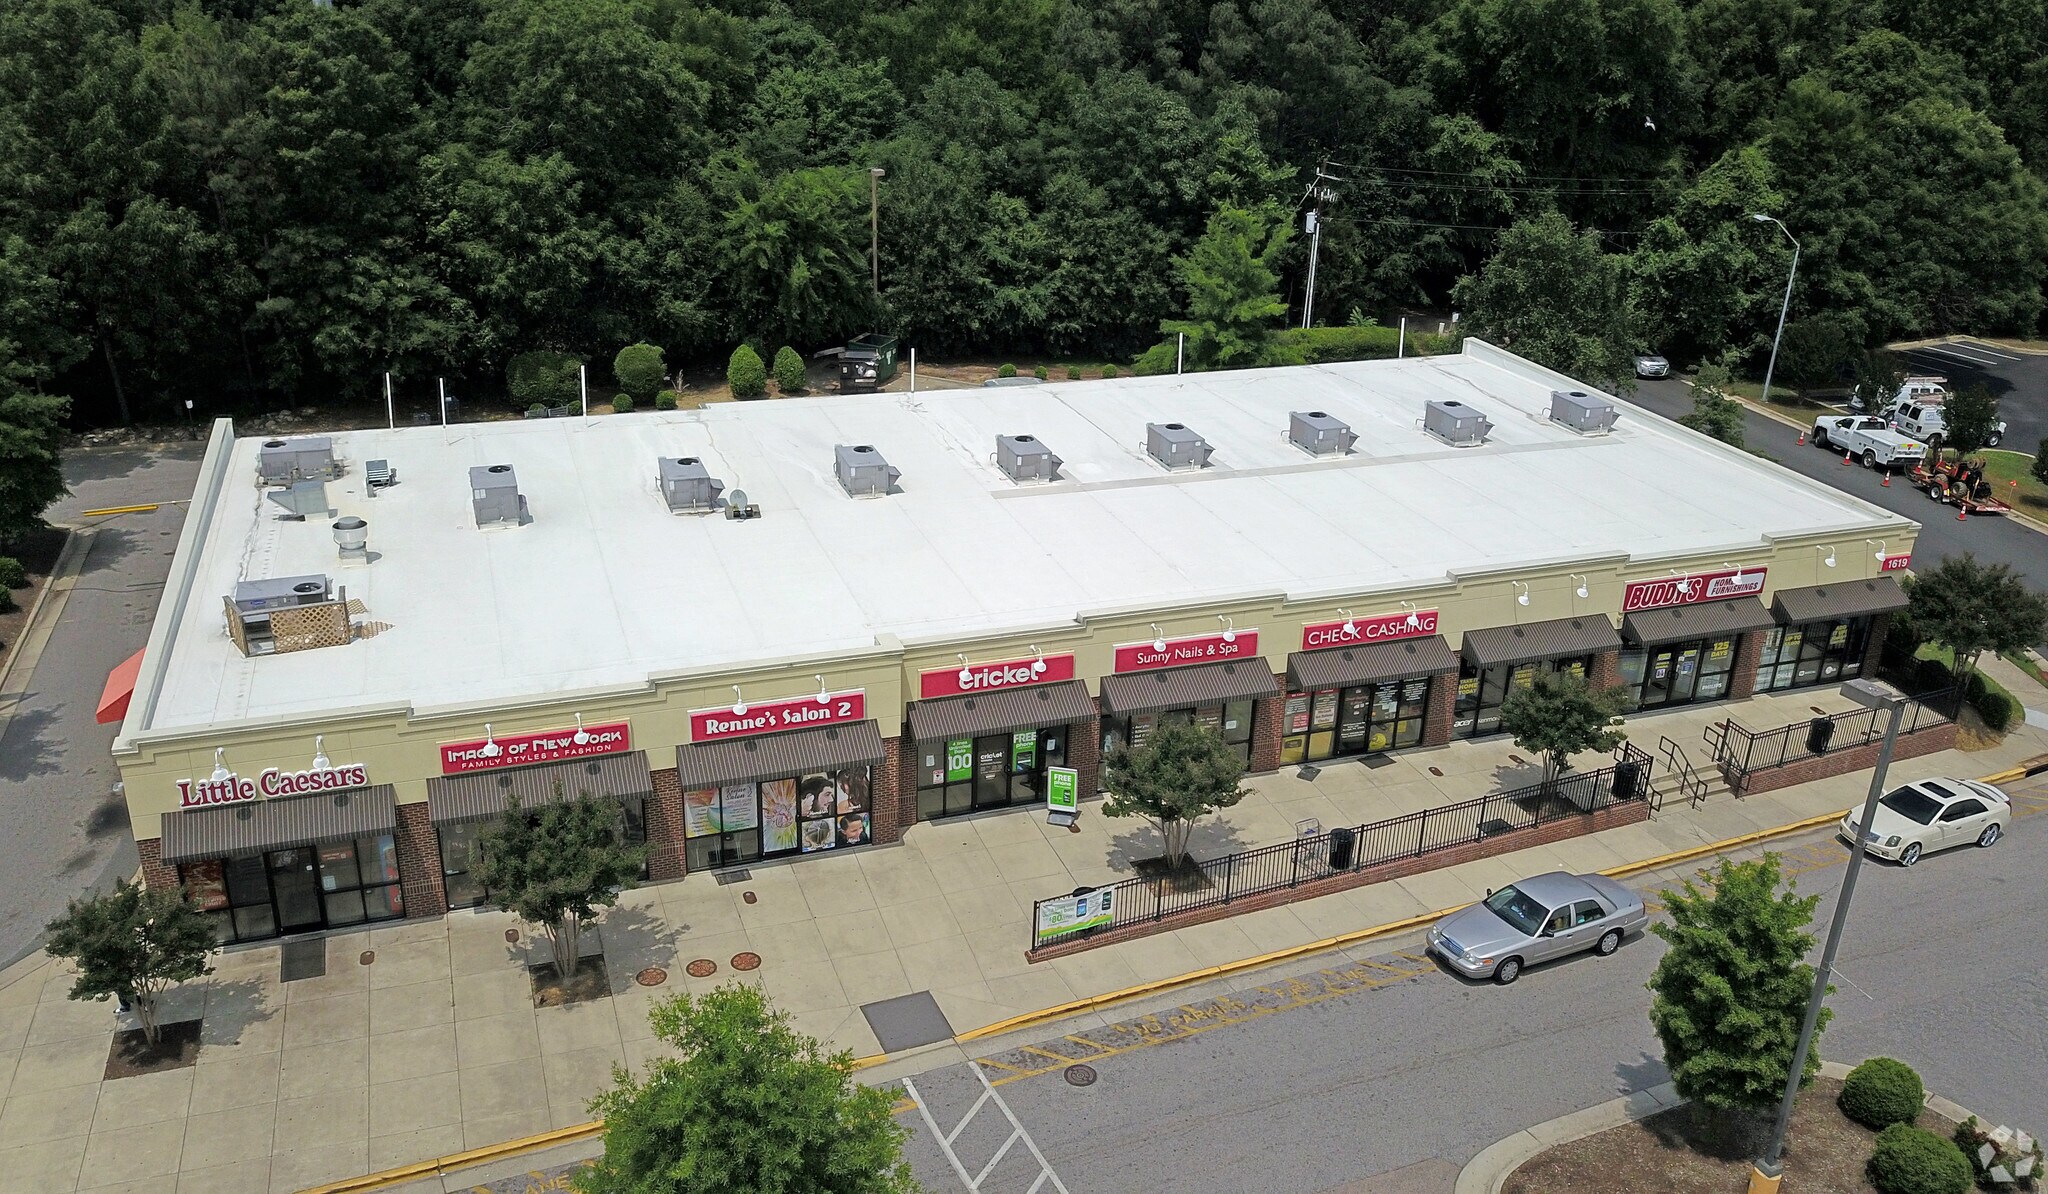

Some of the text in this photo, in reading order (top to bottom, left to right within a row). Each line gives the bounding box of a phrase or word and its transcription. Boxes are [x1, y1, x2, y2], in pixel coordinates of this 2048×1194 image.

[1887, 557, 1908, 569] 1619
[1710, 582, 1760, 596] FURNISHINGS
[1713, 578, 1738, 588] HOM
[1308, 617, 1435, 645] CHECK CASHING
[1713, 641, 1730, 651] 125
[1136, 642, 1239, 665] Sunny Nails & Spa
[1710, 650, 1728, 658] DAYS
[958, 663, 1039, 690] cricket
[705, 701, 852, 735] Renne's Salon 2
[1453, 718, 1475, 728] acer
[1013, 731, 1037, 744] FREE
[447, 745, 504, 763] IMAGS
[508, 743, 529, 755] OF
[532, 737, 573, 752] NEW
[1015, 741, 1034, 749] phone
[461, 758, 502, 770] FAMILY
[506, 751, 547, 764] STYLES
[564, 744, 613, 756] FASHION
[980, 751, 1003, 760] cricket
[1053, 773, 1072, 783] FREE
[1053, 780, 1072, 788] phone
[176, 767, 366, 808] Little Caesars
[1167, 1001, 1246, 1027] PARKING
